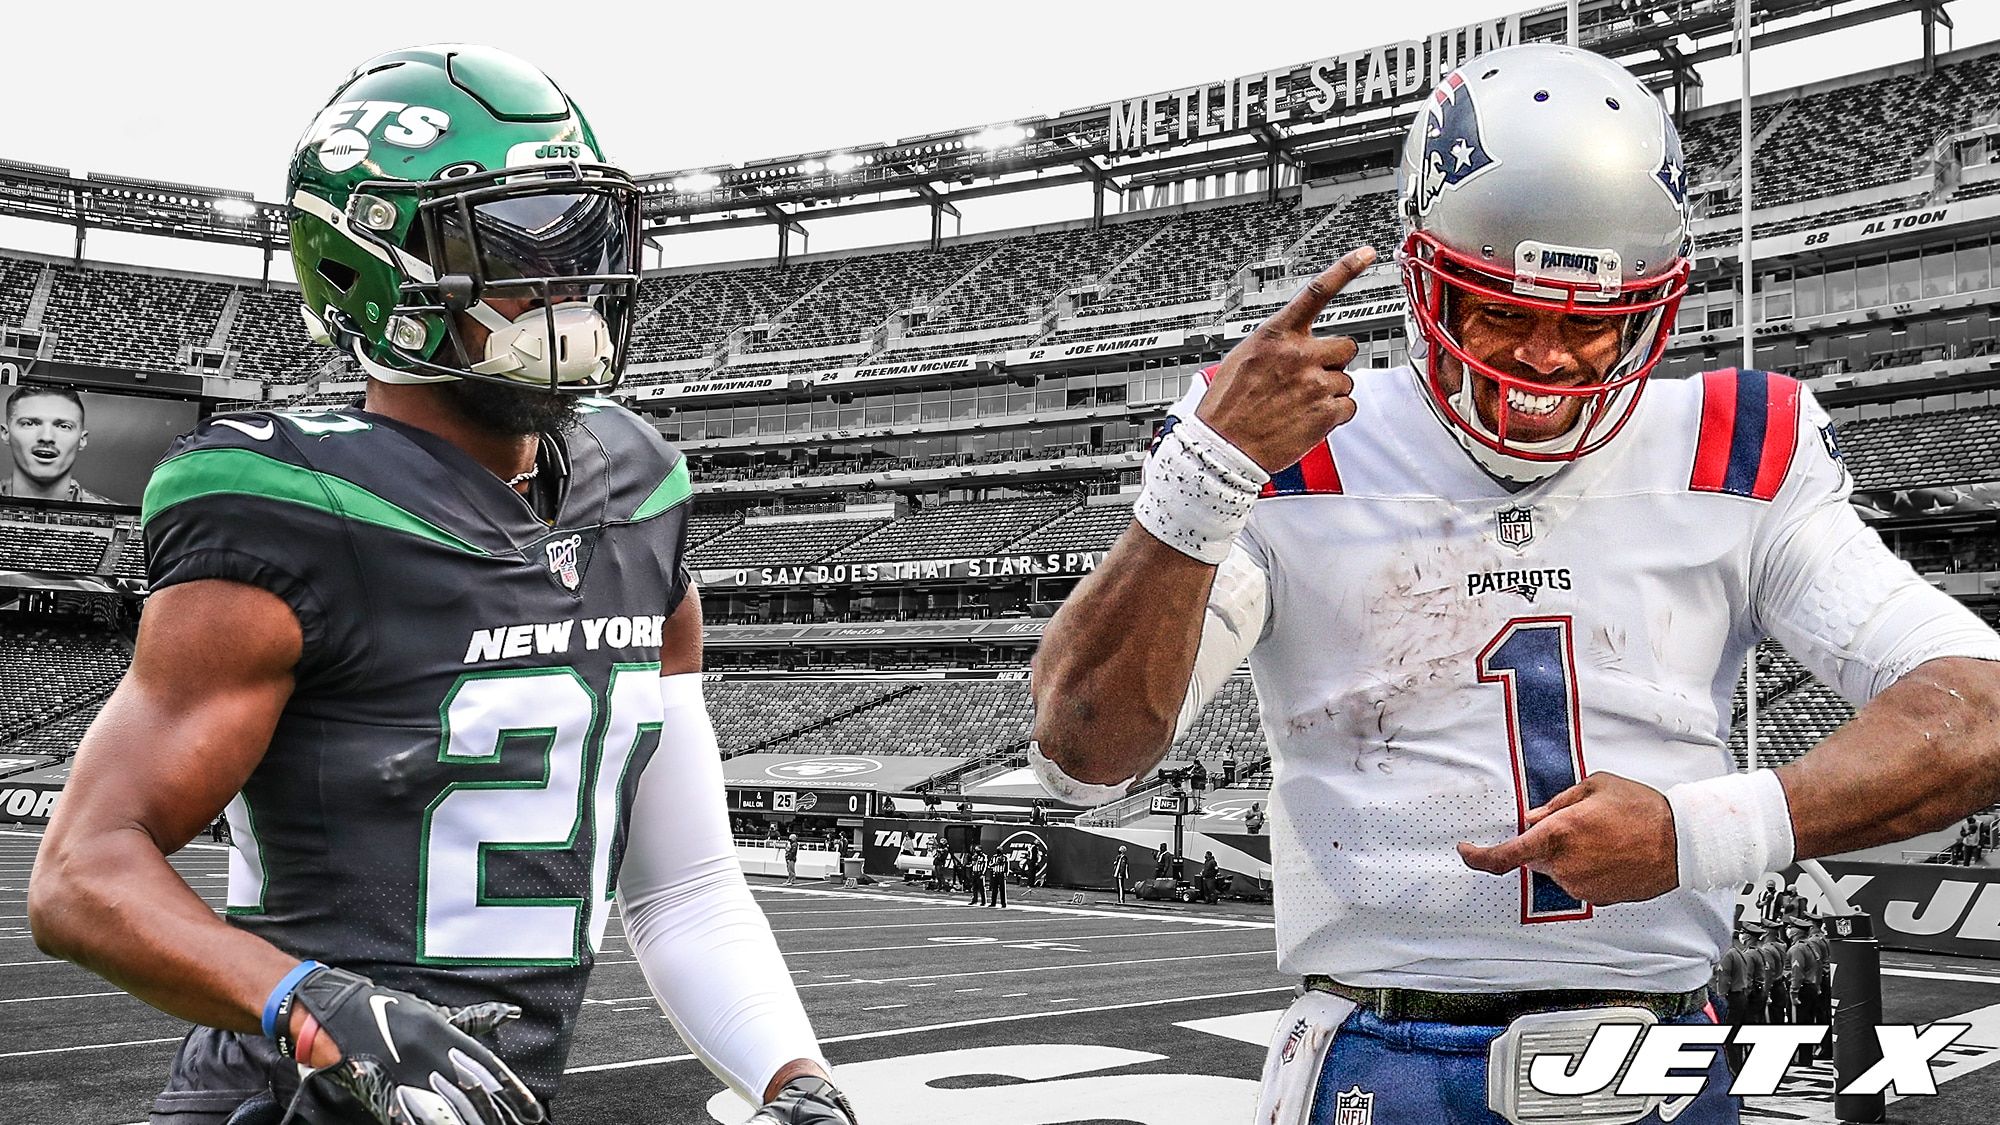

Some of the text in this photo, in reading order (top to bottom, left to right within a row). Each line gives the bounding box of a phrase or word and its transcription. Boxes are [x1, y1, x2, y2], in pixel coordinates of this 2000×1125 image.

[1109, 68, 1292, 152] METLIFE
[535, 144, 580, 158] JETS
[1805, 209, 1948, 246] 88 AL TOON
[1540, 250, 1598, 275] PATRIOTS
[1337, 301, 1406, 321] PHILBIN
[1028, 336, 1159, 360] 12 JOE NAMATH
[820, 358, 970, 382] 24 FREEMAN MCNEIL
[651, 378, 773, 396] 13 DON MAYNARD
[1503, 523, 1530, 541] NFL
[735, 552, 1108, 587] O SAY DOES THAT STAR-SPA
[1467, 568, 1572, 597] PATRIOTS
[463, 615, 666, 664] NEW YORK
[838, 628, 886, 636] MetLife
[996, 672, 1026, 680] NEW
[1476, 616, 1593, 925] 1
[742, 800, 755, 808] BALL
[777, 794, 791, 808] 25
[849, 795, 857, 812] 0
[1161, 800, 1177, 809] NFL
[1073, 893, 1084, 903] 20
